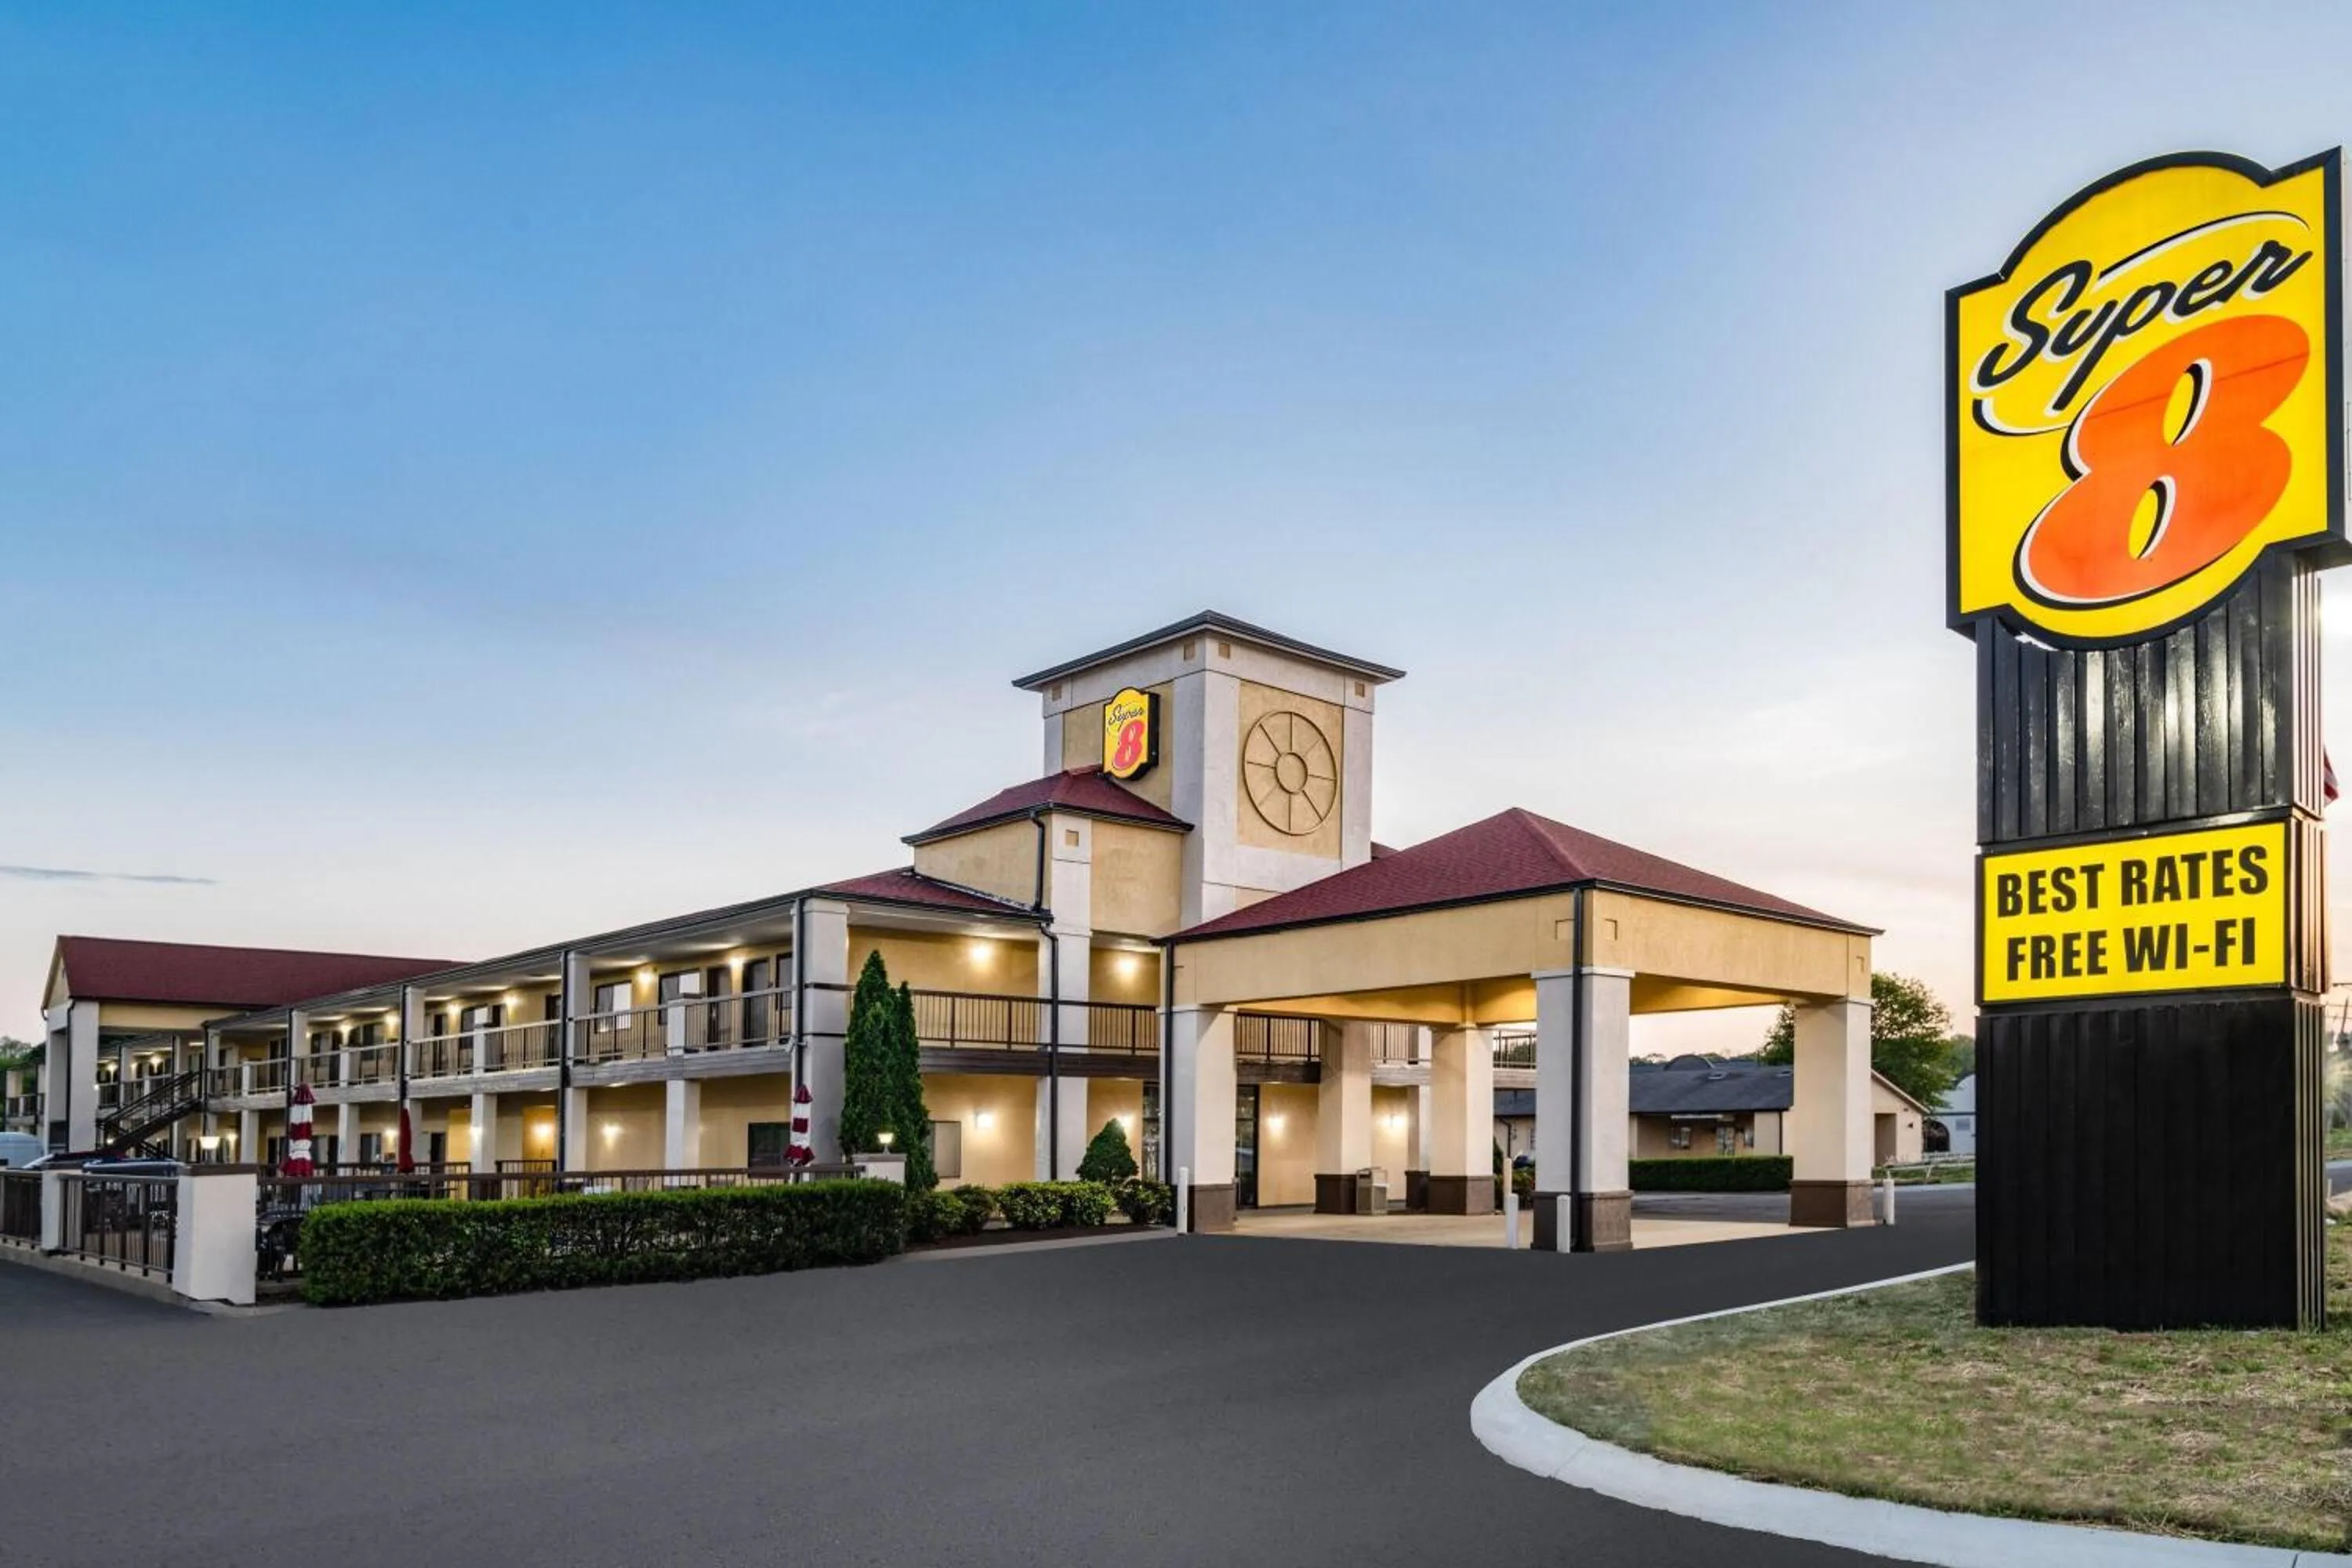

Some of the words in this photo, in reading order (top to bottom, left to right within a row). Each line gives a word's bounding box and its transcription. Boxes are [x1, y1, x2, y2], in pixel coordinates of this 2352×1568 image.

[1976, 239, 2314, 412] Super
[2013, 314, 2310, 611] 8
[1112, 719, 1145, 770] 8
[1997, 863, 2105, 918] BEST
[2121, 845, 2268, 906] RATES
[2007, 930, 2107, 982] FREE
[2123, 917, 2256, 973] WI-FI
